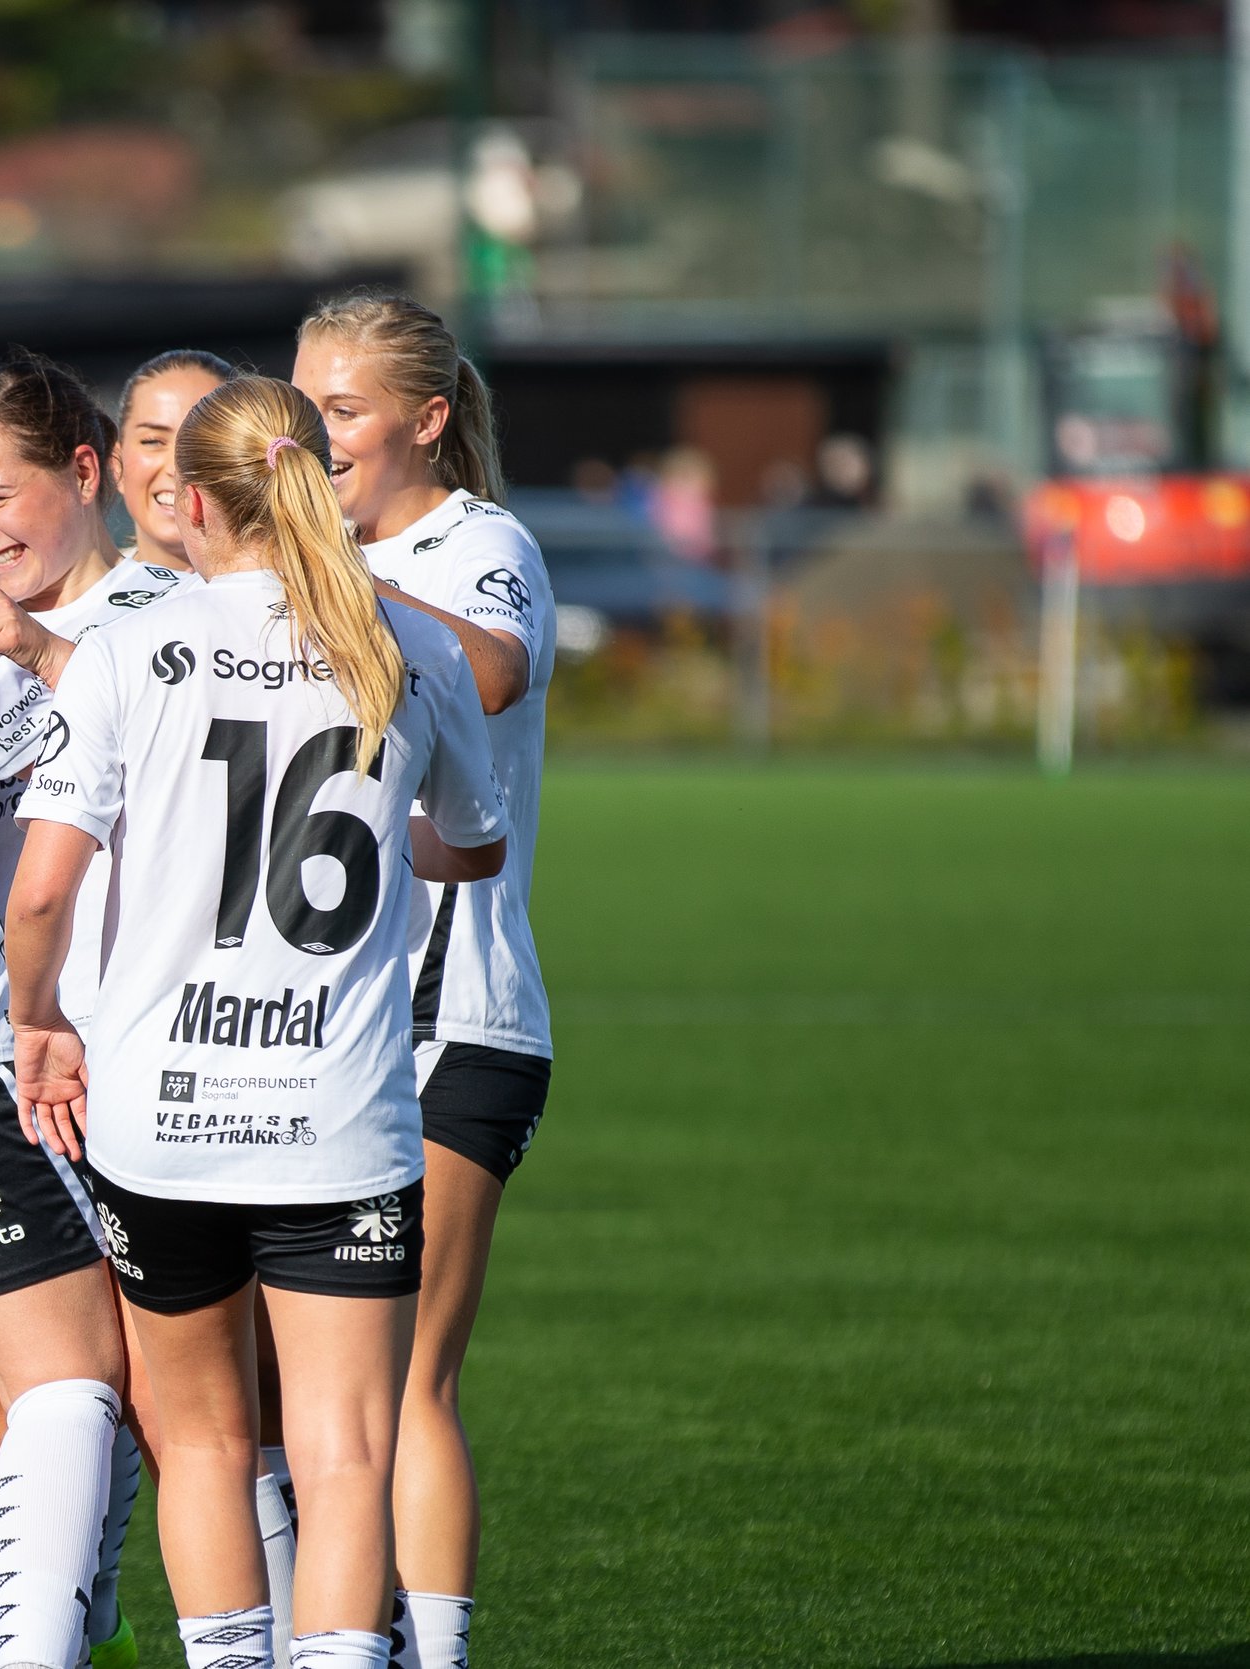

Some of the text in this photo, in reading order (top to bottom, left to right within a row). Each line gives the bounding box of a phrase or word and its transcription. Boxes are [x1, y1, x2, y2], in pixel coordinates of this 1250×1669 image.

[213, 649, 421, 697] Sognet
[35, 773, 76, 797] Sogn
[201, 717, 387, 956] 16
[168, 981, 330, 1049] Mardal
[202, 1076, 318, 1090] FAGFORBUNDET
[201, 1091, 239, 1101] Sogndal
[155, 1124, 282, 1145] KREFTTRÅKK
[333, 1242, 406, 1262] mesta
